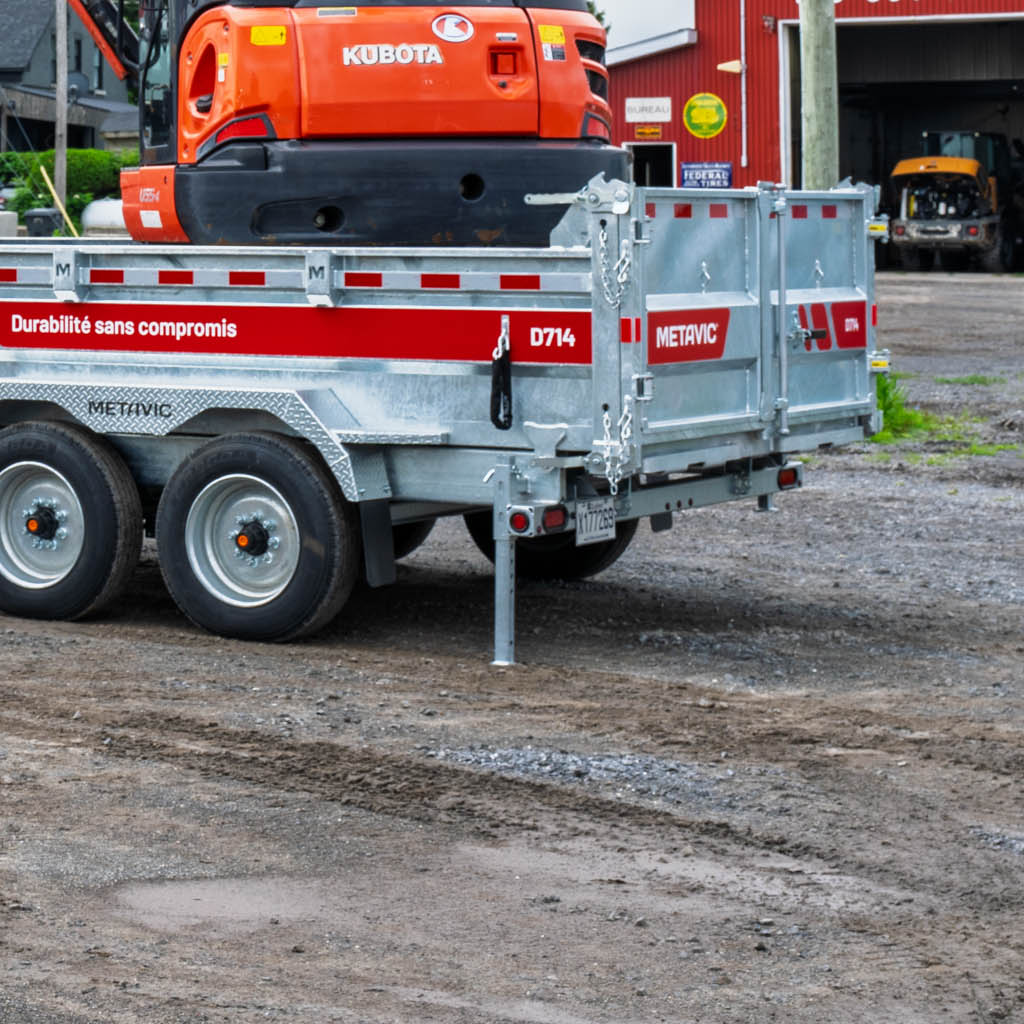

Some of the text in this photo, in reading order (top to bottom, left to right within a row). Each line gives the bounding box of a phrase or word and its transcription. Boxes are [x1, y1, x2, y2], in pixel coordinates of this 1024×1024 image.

[342, 43, 444, 66] KUBOTA
[626, 104, 670, 114] BUREAU
[684, 170, 729, 180] FEDERAL
[700, 179, 729, 187] TIRES
[56, 263, 70, 276] M
[308, 266, 324, 280] M
[11, 314, 238, 341] Durabilité sans compromis
[656, 322, 718, 349] METAVIC
[530, 327, 576, 347] D714
[87, 400, 173, 418] METAVIC
